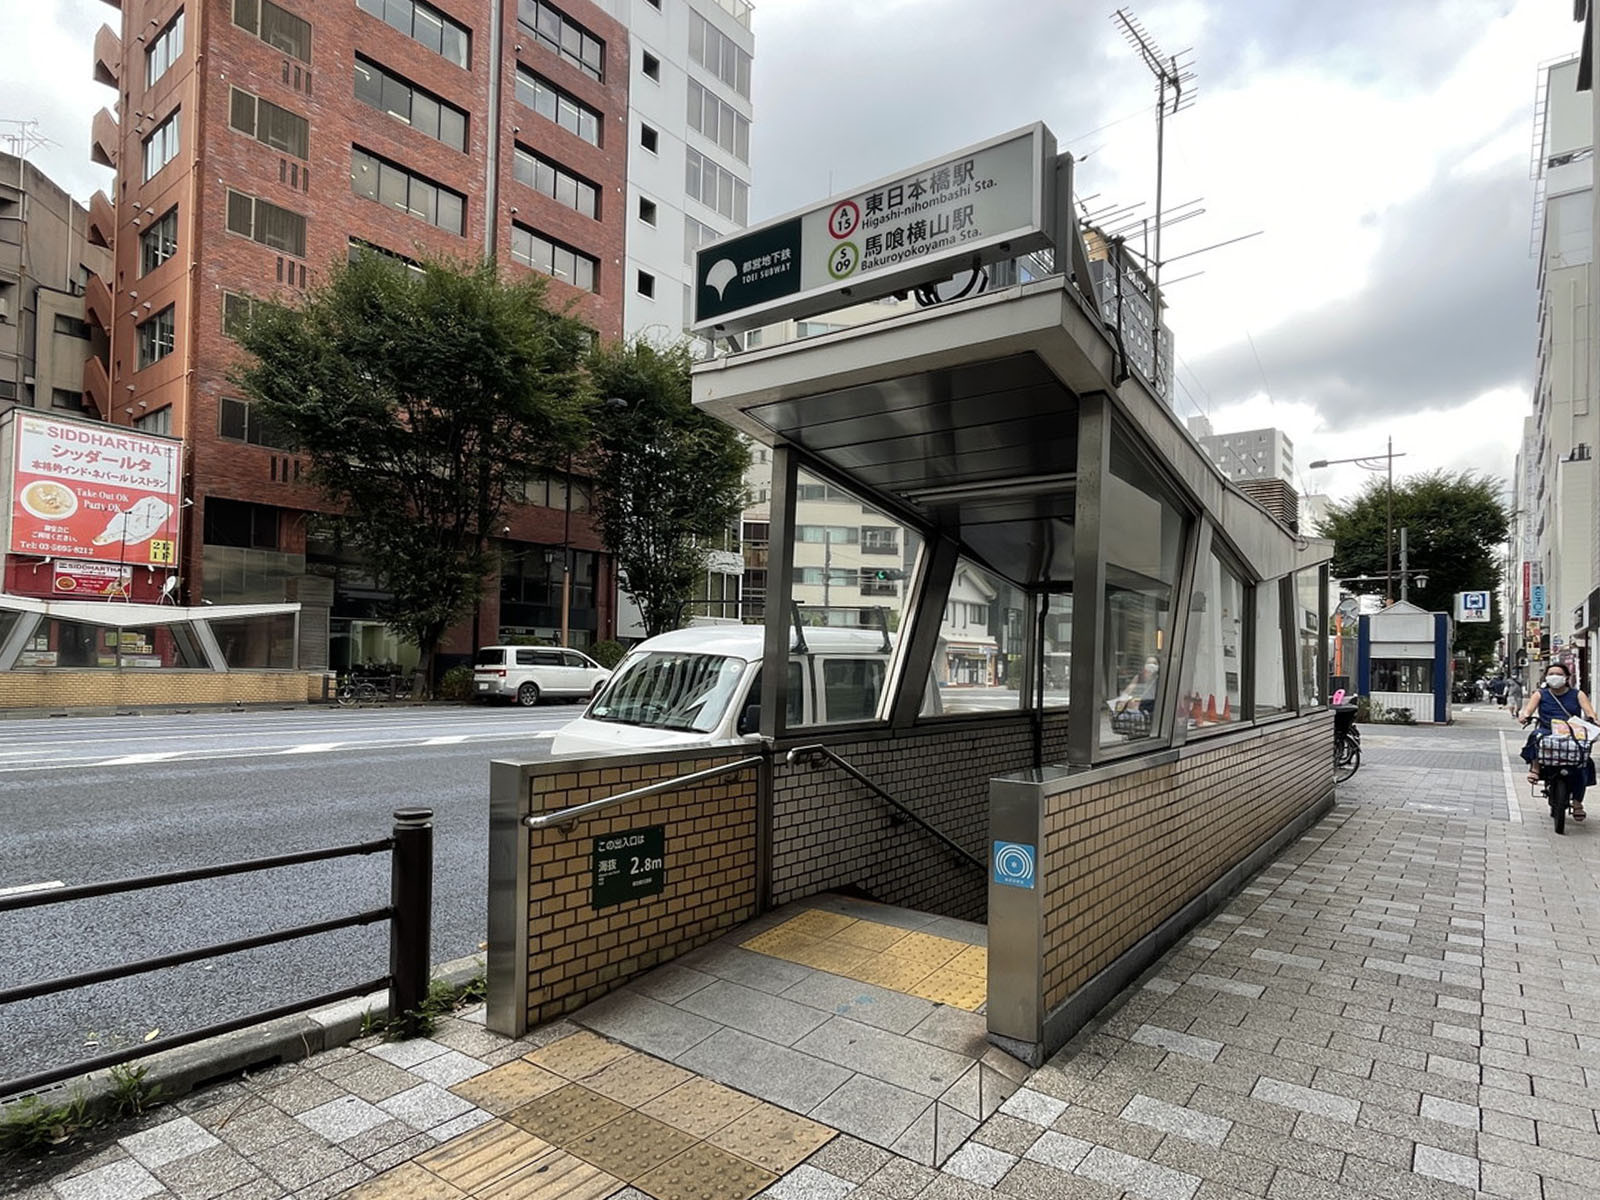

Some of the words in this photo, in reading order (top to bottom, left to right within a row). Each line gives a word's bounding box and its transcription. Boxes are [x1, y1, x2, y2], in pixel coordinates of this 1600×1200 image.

[865, 160, 975, 217] 東日本橋駅
[840, 208, 848, 219] A
[862, 186, 971, 230] Higashi-nihombashi
[974, 178, 998, 193] Sta.
[837, 219, 851, 232] 15
[864, 204, 974, 258] 馬喰横山駅
[742, 248, 791, 273] 都営地下鉄
[840, 248, 847, 259] S
[861, 235, 956, 271] Bakuroyokoyama
[960, 227, 982, 241] Sta.
[742, 272, 758, 284] TOEI
[760, 261, 791, 279] SUBWAY
[835, 259, 851, 273] 09
[47, 426, 162, 457] SIDDHARTHA
[51, 444, 152, 471] シッダールタ
[76, 487, 97, 496] Take
[116, 493, 129, 502] OK
[598, 835, 645, 852] この出入口は
[630, 857, 662, 875] 2.8m
